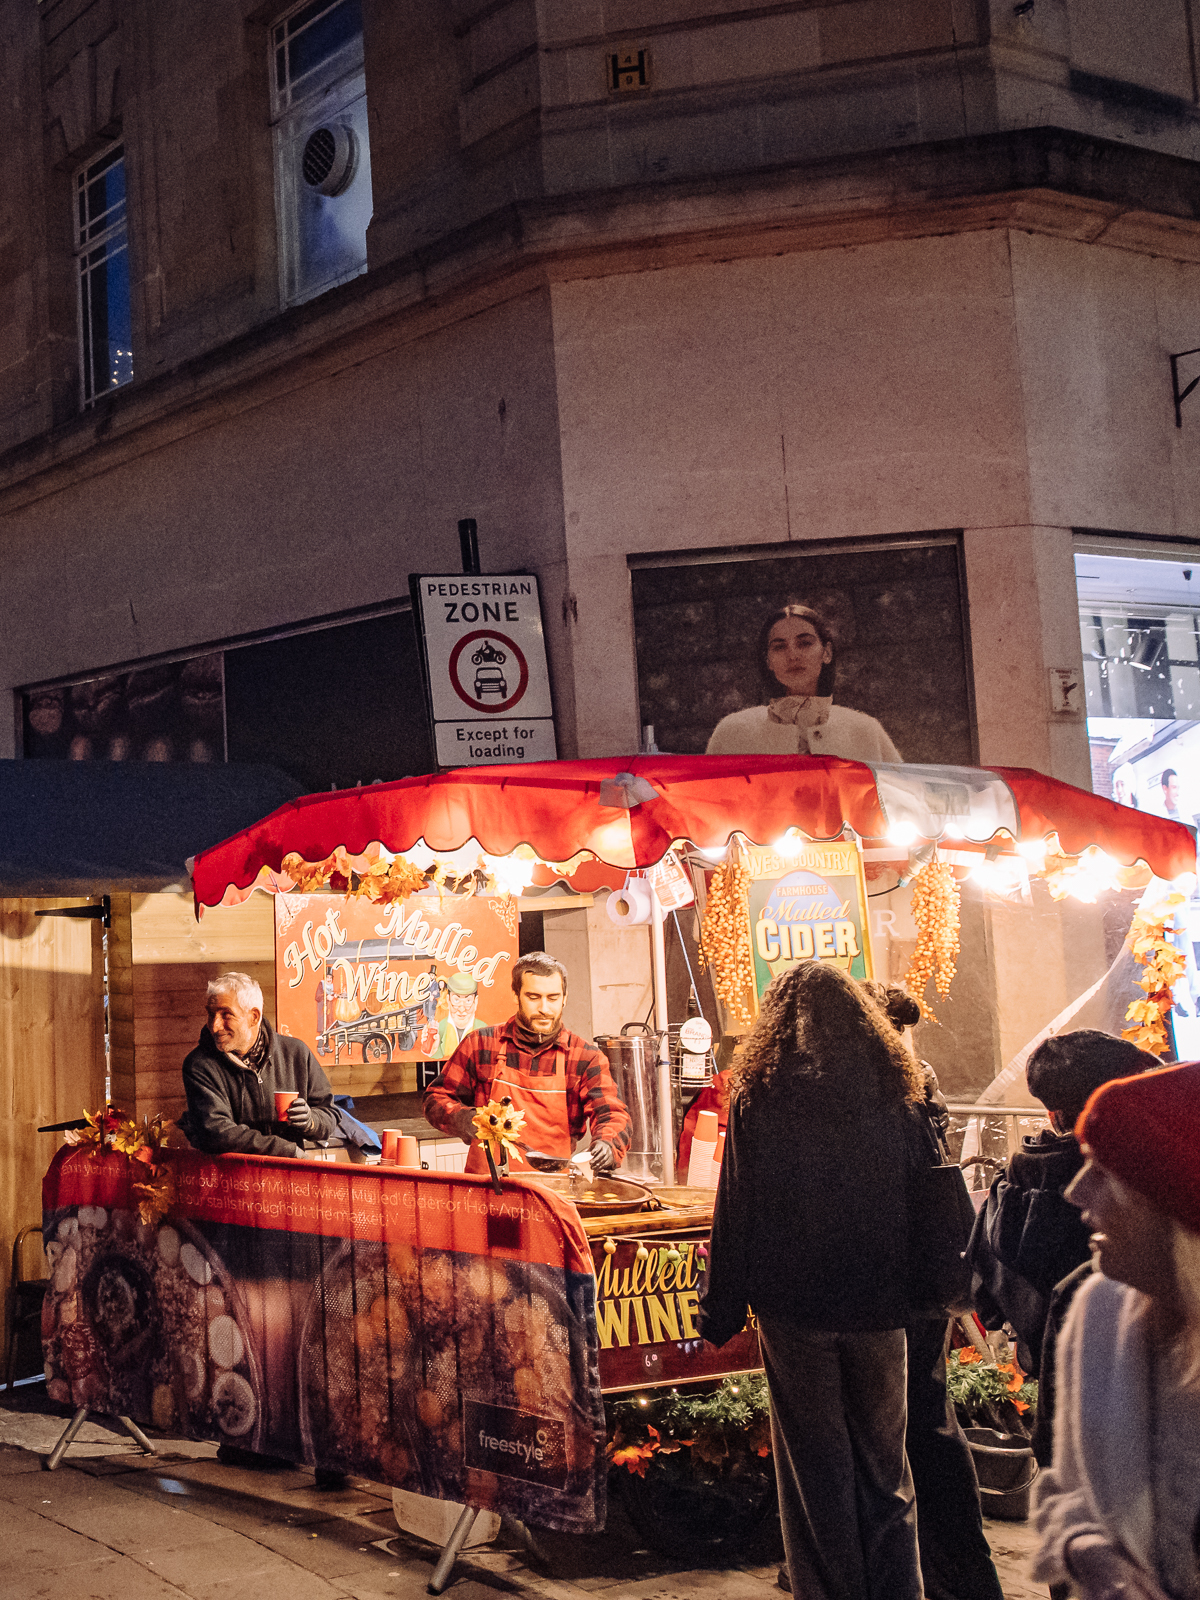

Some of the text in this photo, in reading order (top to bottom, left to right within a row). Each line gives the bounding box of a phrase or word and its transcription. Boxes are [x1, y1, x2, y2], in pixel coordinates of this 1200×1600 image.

[427, 582, 532, 596] PEDESTRIAN
[444, 601, 520, 623] ZONE
[456, 726, 535, 743] Except for
[468, 743, 525, 759] loading
[745, 850, 852, 877] WEST COUNTRY
[776, 884, 828, 897] FARMHOUSE
[758, 899, 851, 922] Mulled
[283, 903, 511, 989] Hot Mulled
[755, 918, 861, 961] CIDER
[332, 958, 433, 1004] Wine
[207, 1196, 237, 1210] stalls
[252, 1179, 266, 1193] of
[267, 1180, 310, 1197] Mulled
[402, 1192, 445, 1211] Cder
[595, 1290, 701, 1350] WINE
[478, 1429, 544, 1464] freestyle
